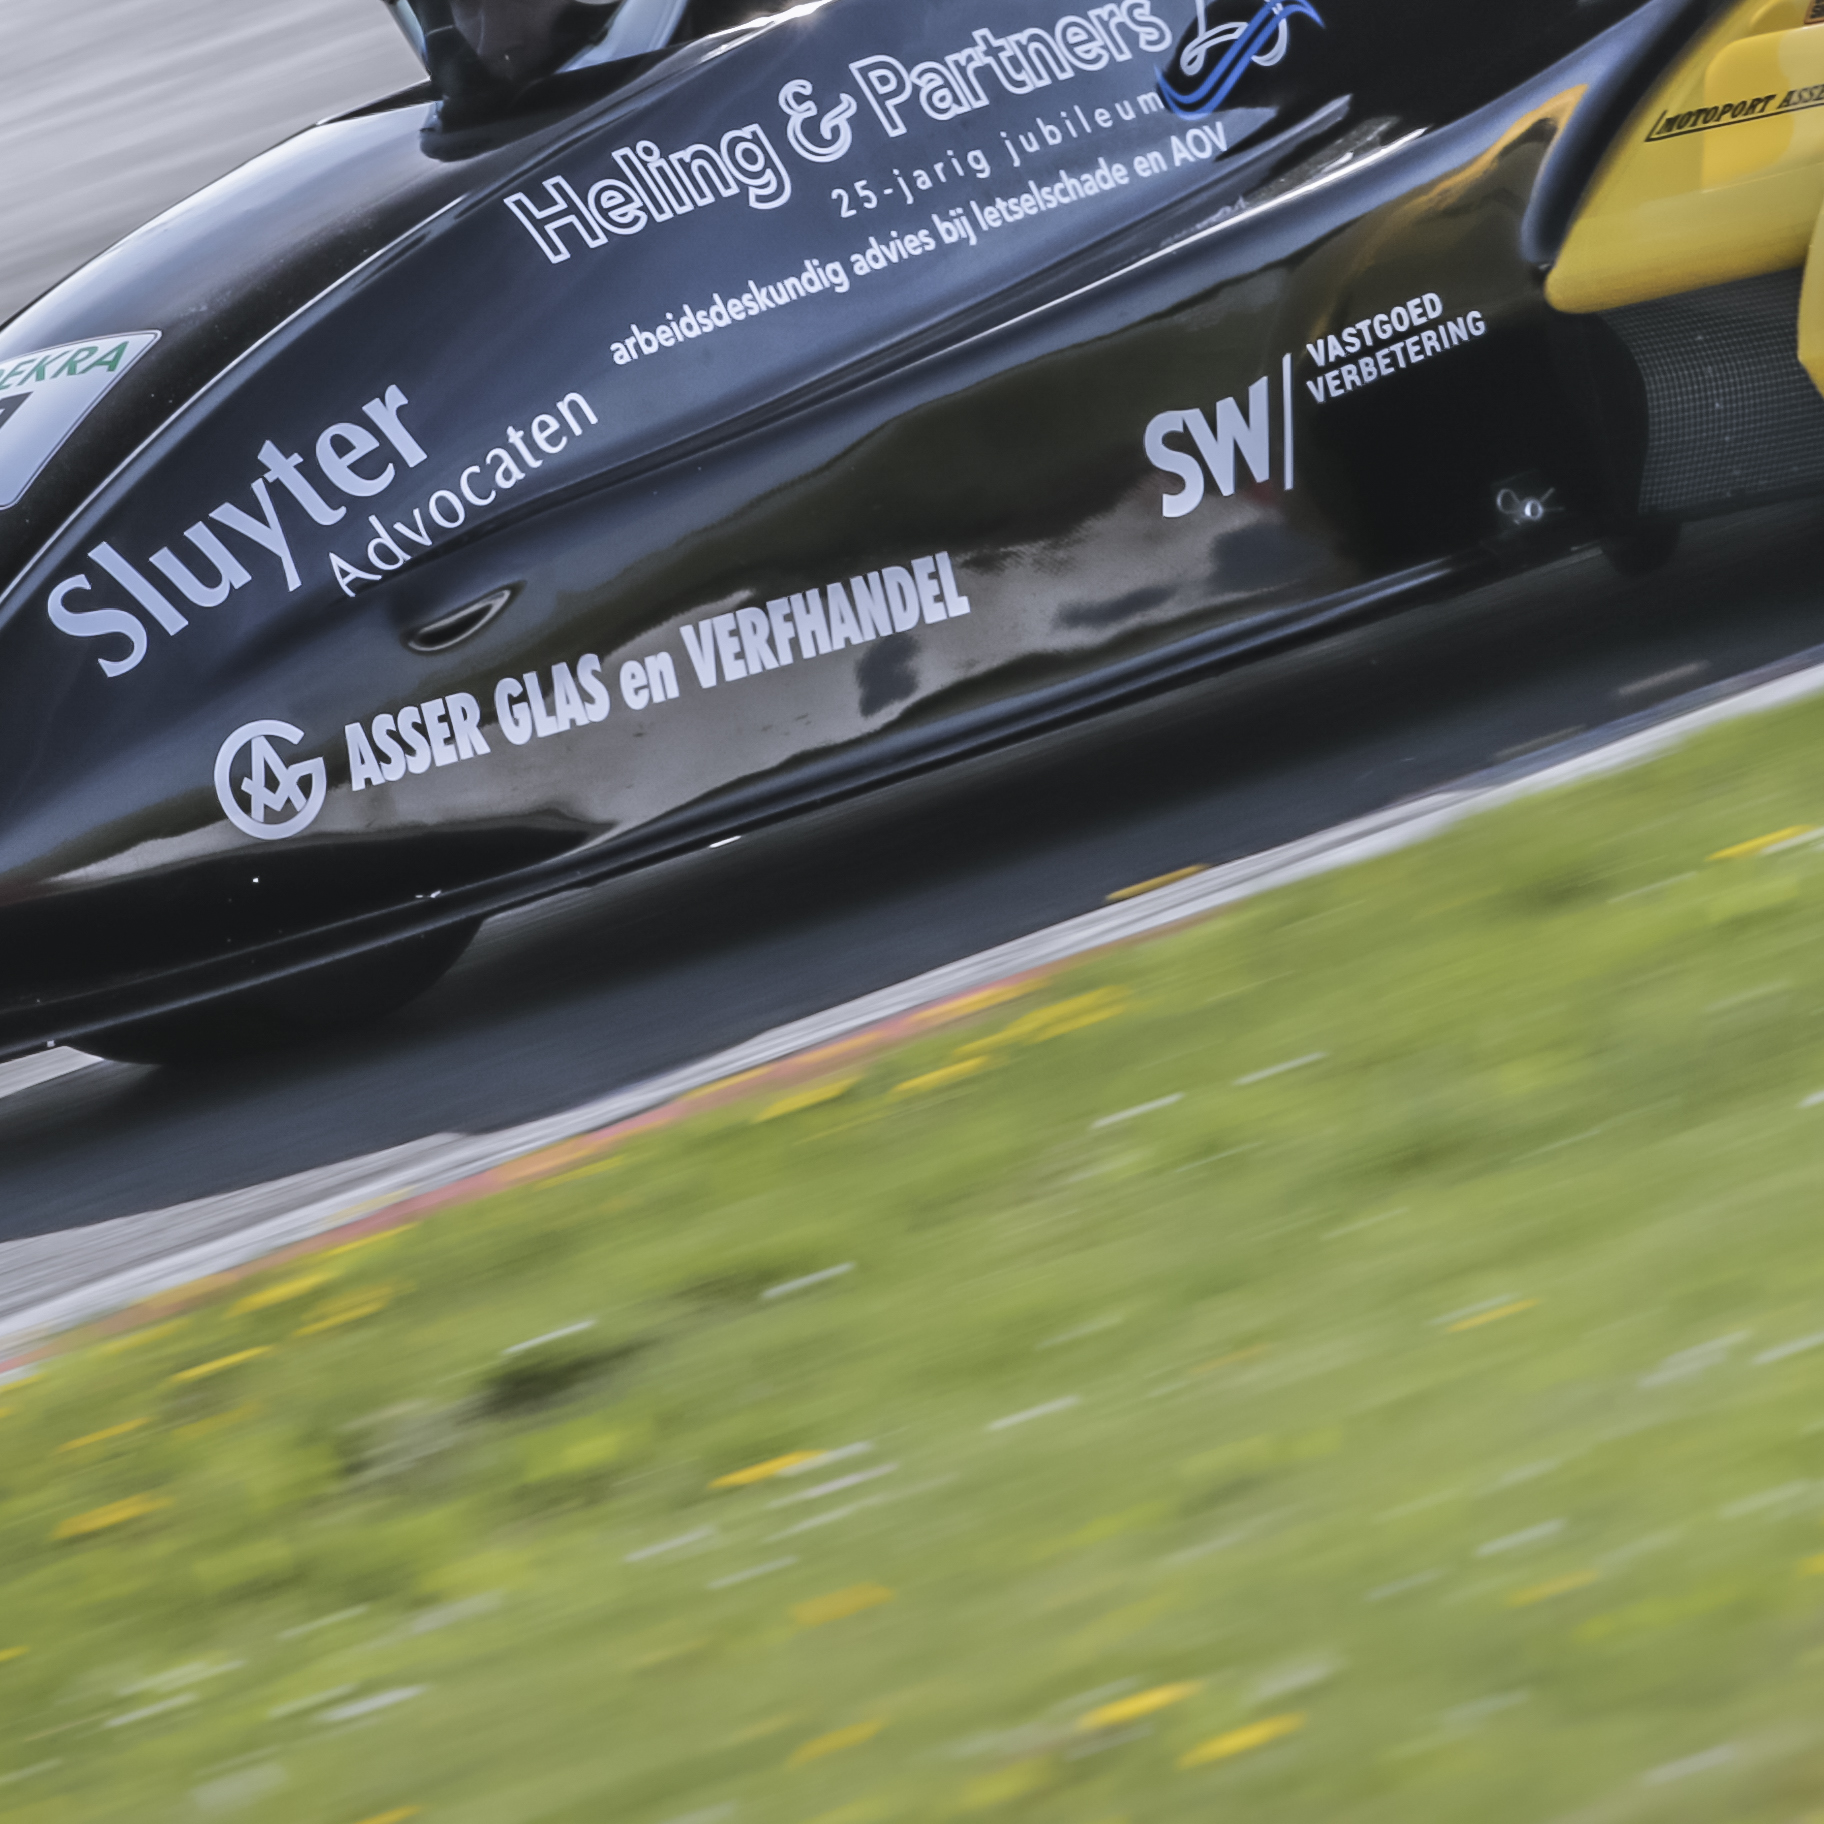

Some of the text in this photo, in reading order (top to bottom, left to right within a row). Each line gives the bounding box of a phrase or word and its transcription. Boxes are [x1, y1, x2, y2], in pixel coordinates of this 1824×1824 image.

[503, 122, 792, 265] Heling
[779, 79, 858, 162] &
[831, 91, 1165, 218] 25-jarig jubileum
[1655, 93, 1778, 135] MOTOPORT
[610, 121, 1228, 365] arbeidsdeskundig advies bij letselschade en AOV
[1306, 292, 1443, 367] VASTGOED
[1306, 311, 1486, 404] VERBETERING
[47, 384, 428, 677] Sluyter
[329, 390, 599, 597] Advocaten
[344, 551, 971, 792] ASSER GLAS en VERFHANDEL
